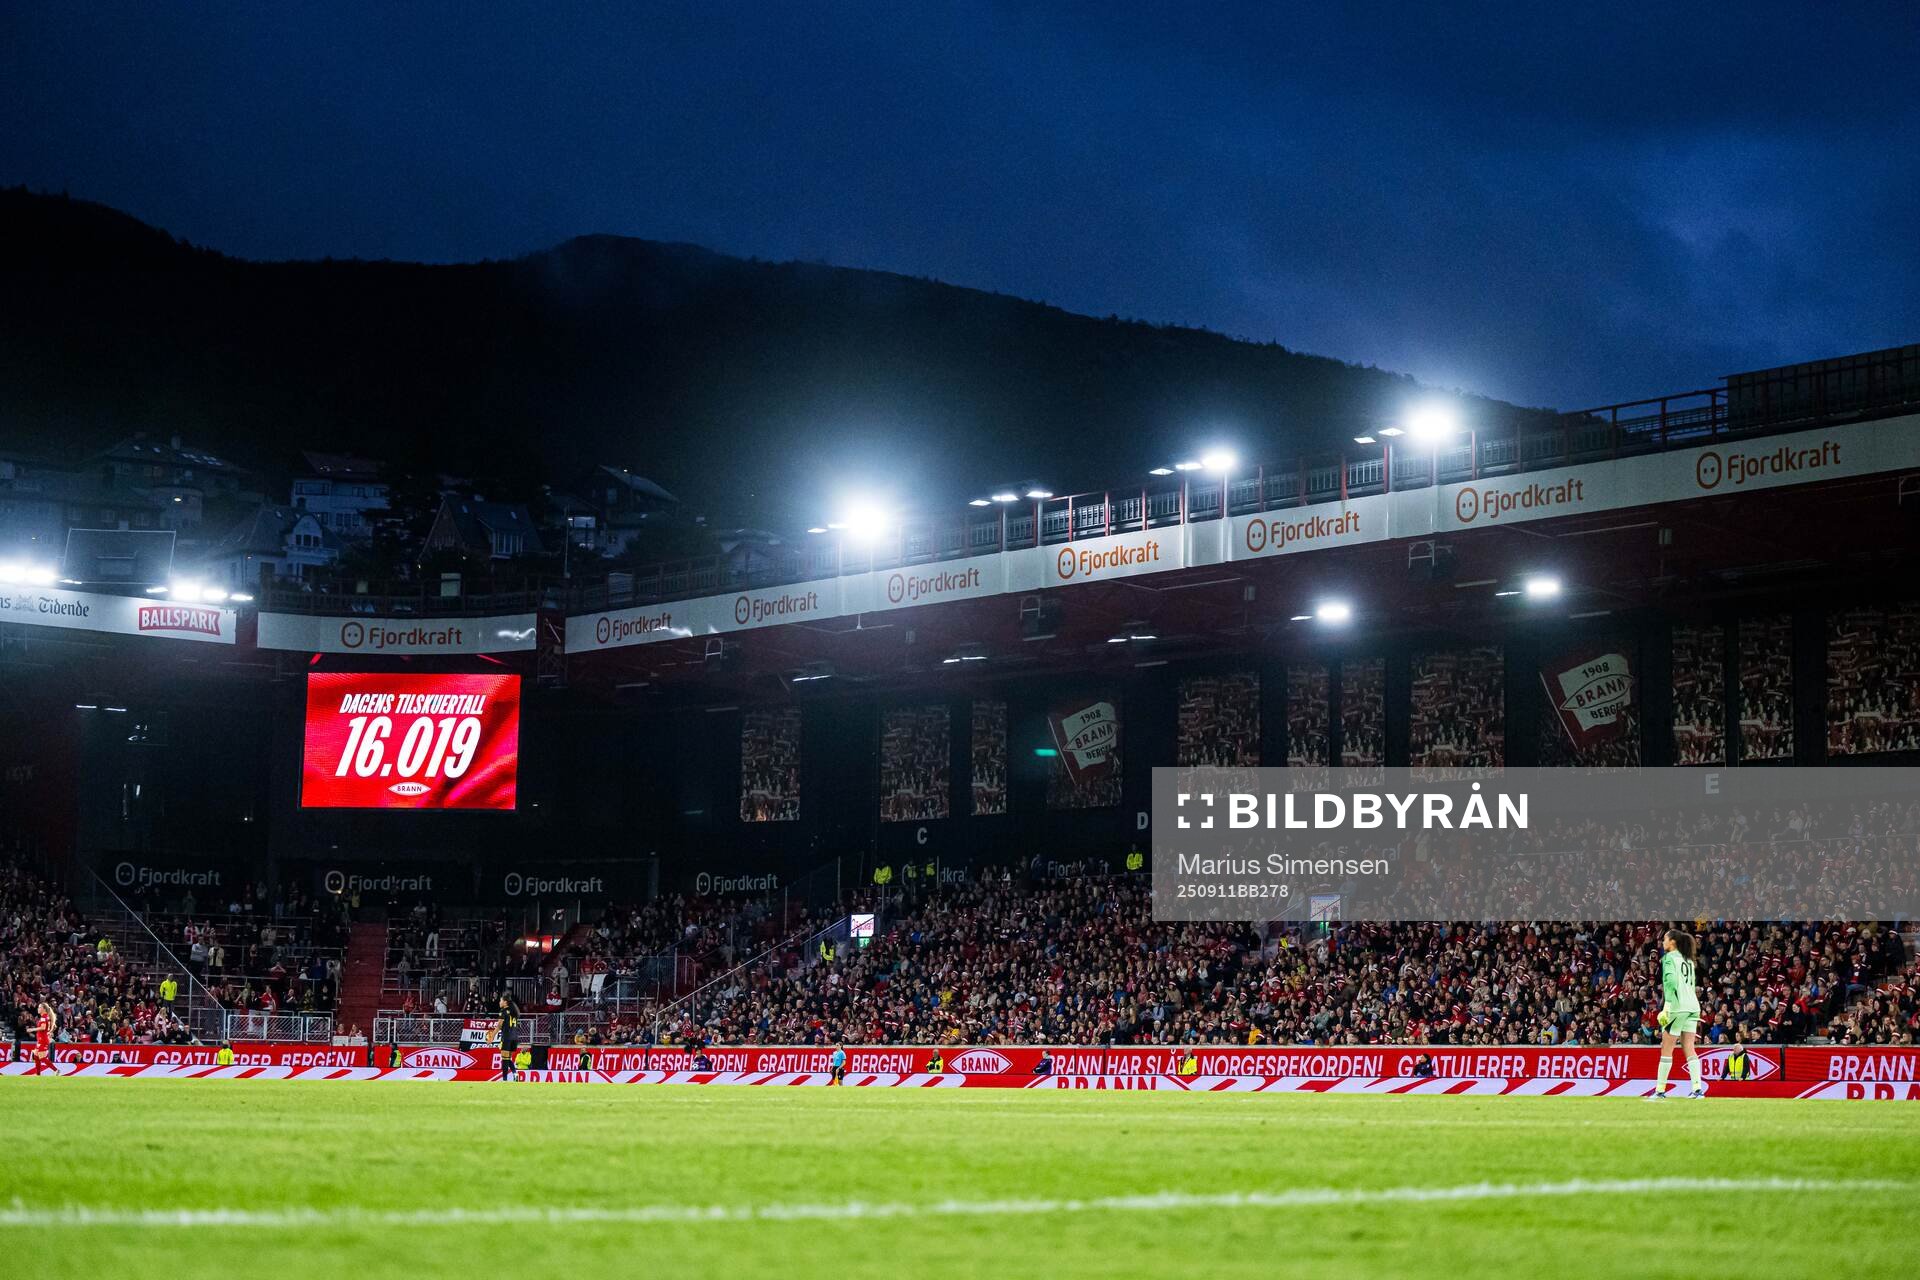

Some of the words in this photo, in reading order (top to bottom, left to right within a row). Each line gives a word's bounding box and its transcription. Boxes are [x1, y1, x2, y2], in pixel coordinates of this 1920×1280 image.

[1727, 441, 1841, 484] Fjordkraft
[1483, 478, 1584, 519] Fjordkraft
[1270, 511, 1360, 548] Fjordkraft
[1079, 541, 1159, 576] Fjordkraft
[907, 568, 980, 600] Fjordkraft
[38, 596, 90, 617] Tidende
[752, 592, 819, 622] Fjordkraft
[141, 609, 219, 632] BALLSPARK
[612, 612, 673, 642] Fjordkraft
[369, 627, 463, 648] Fjordkraft
[1582, 662, 1610, 678] 1908
[1575, 677, 1626, 707] BRANN
[339, 693, 395, 714] DAGENS
[395, 694, 487, 715] TILSKUERTALL
[1079, 709, 1102, 724] 1908
[1074, 723, 1114, 748] BRANN
[335, 716, 482, 778] 16.019
[396, 785, 423, 793] BRANN
[1705, 773, 1720, 795] E
[1136, 812, 1149, 830] D
[916, 827, 928, 845] C
[138, 867, 221, 888] Fjordkraft
[525, 877, 603, 897] Fjordkraft
[713, 873, 779, 895] Fjordkraft
[1681, 962, 1693, 986] 91
[508, 1015, 517, 1028] 14
[415, 1055, 462, 1068] BRANN
[852, 1055, 914, 1073] BERGEN!
[961, 1057, 1000, 1072] BRANN
[1106, 1055, 1142, 1075] HAR
[1200, 1055, 1384, 1077] NORGESREKORDEN!
[1536, 1055, 1629, 1079] BERGEN!
[1701, 1058, 1759, 1076] BRN
[1828, 1055, 1917, 1080] BRANN
